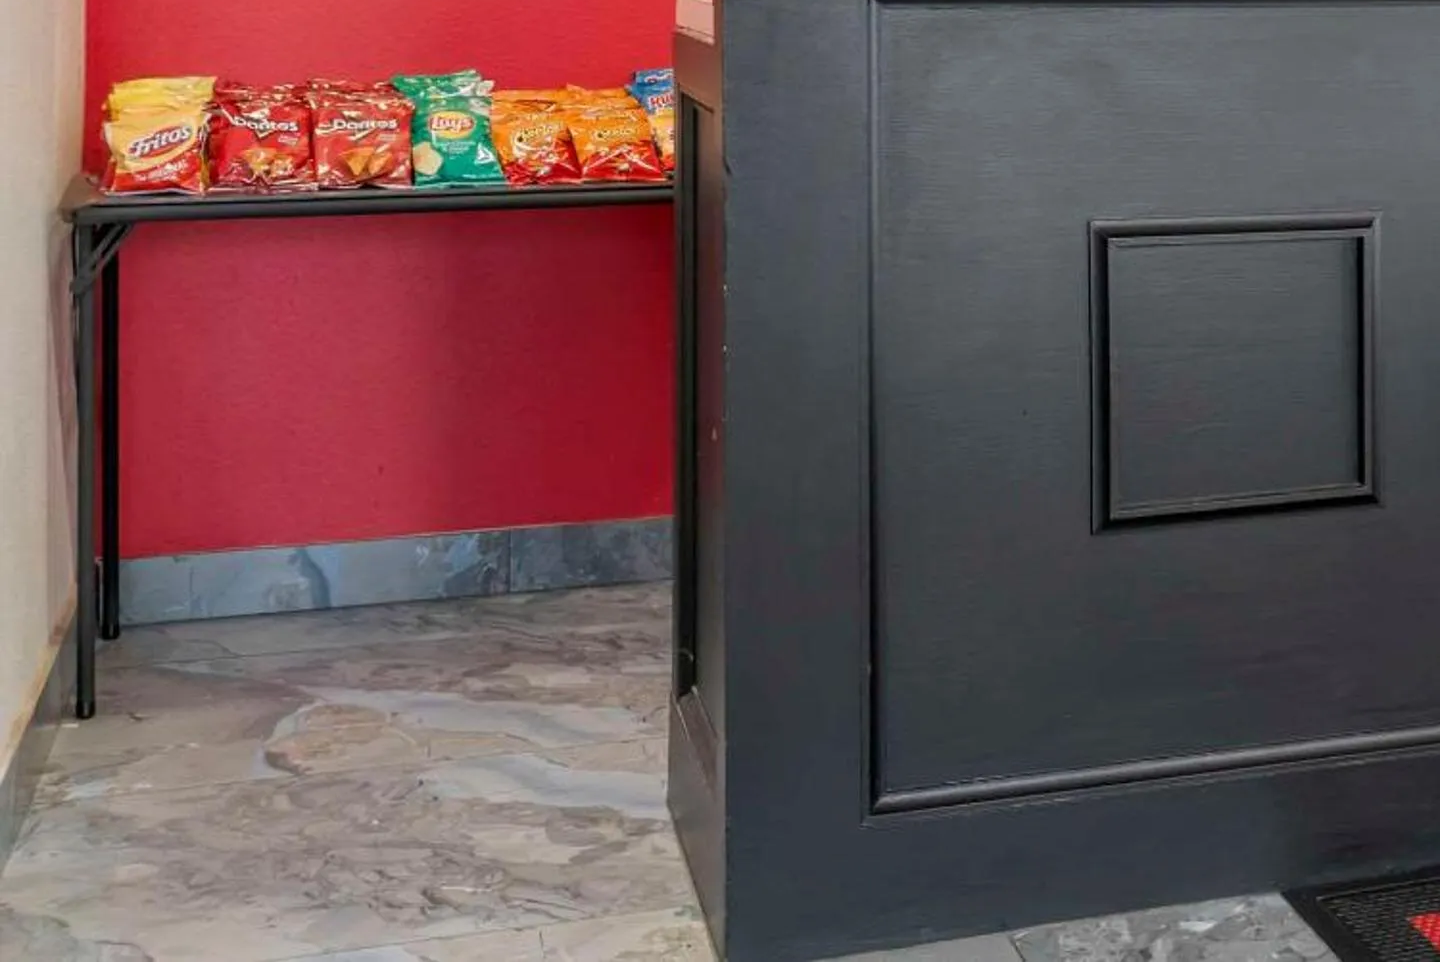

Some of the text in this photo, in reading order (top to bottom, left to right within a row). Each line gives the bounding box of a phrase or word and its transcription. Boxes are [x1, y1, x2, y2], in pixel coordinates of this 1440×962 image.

[231, 116, 298, 132] Doritos
[332, 117, 397, 131] Doritos
[128, 124, 193, 156] Fritos
